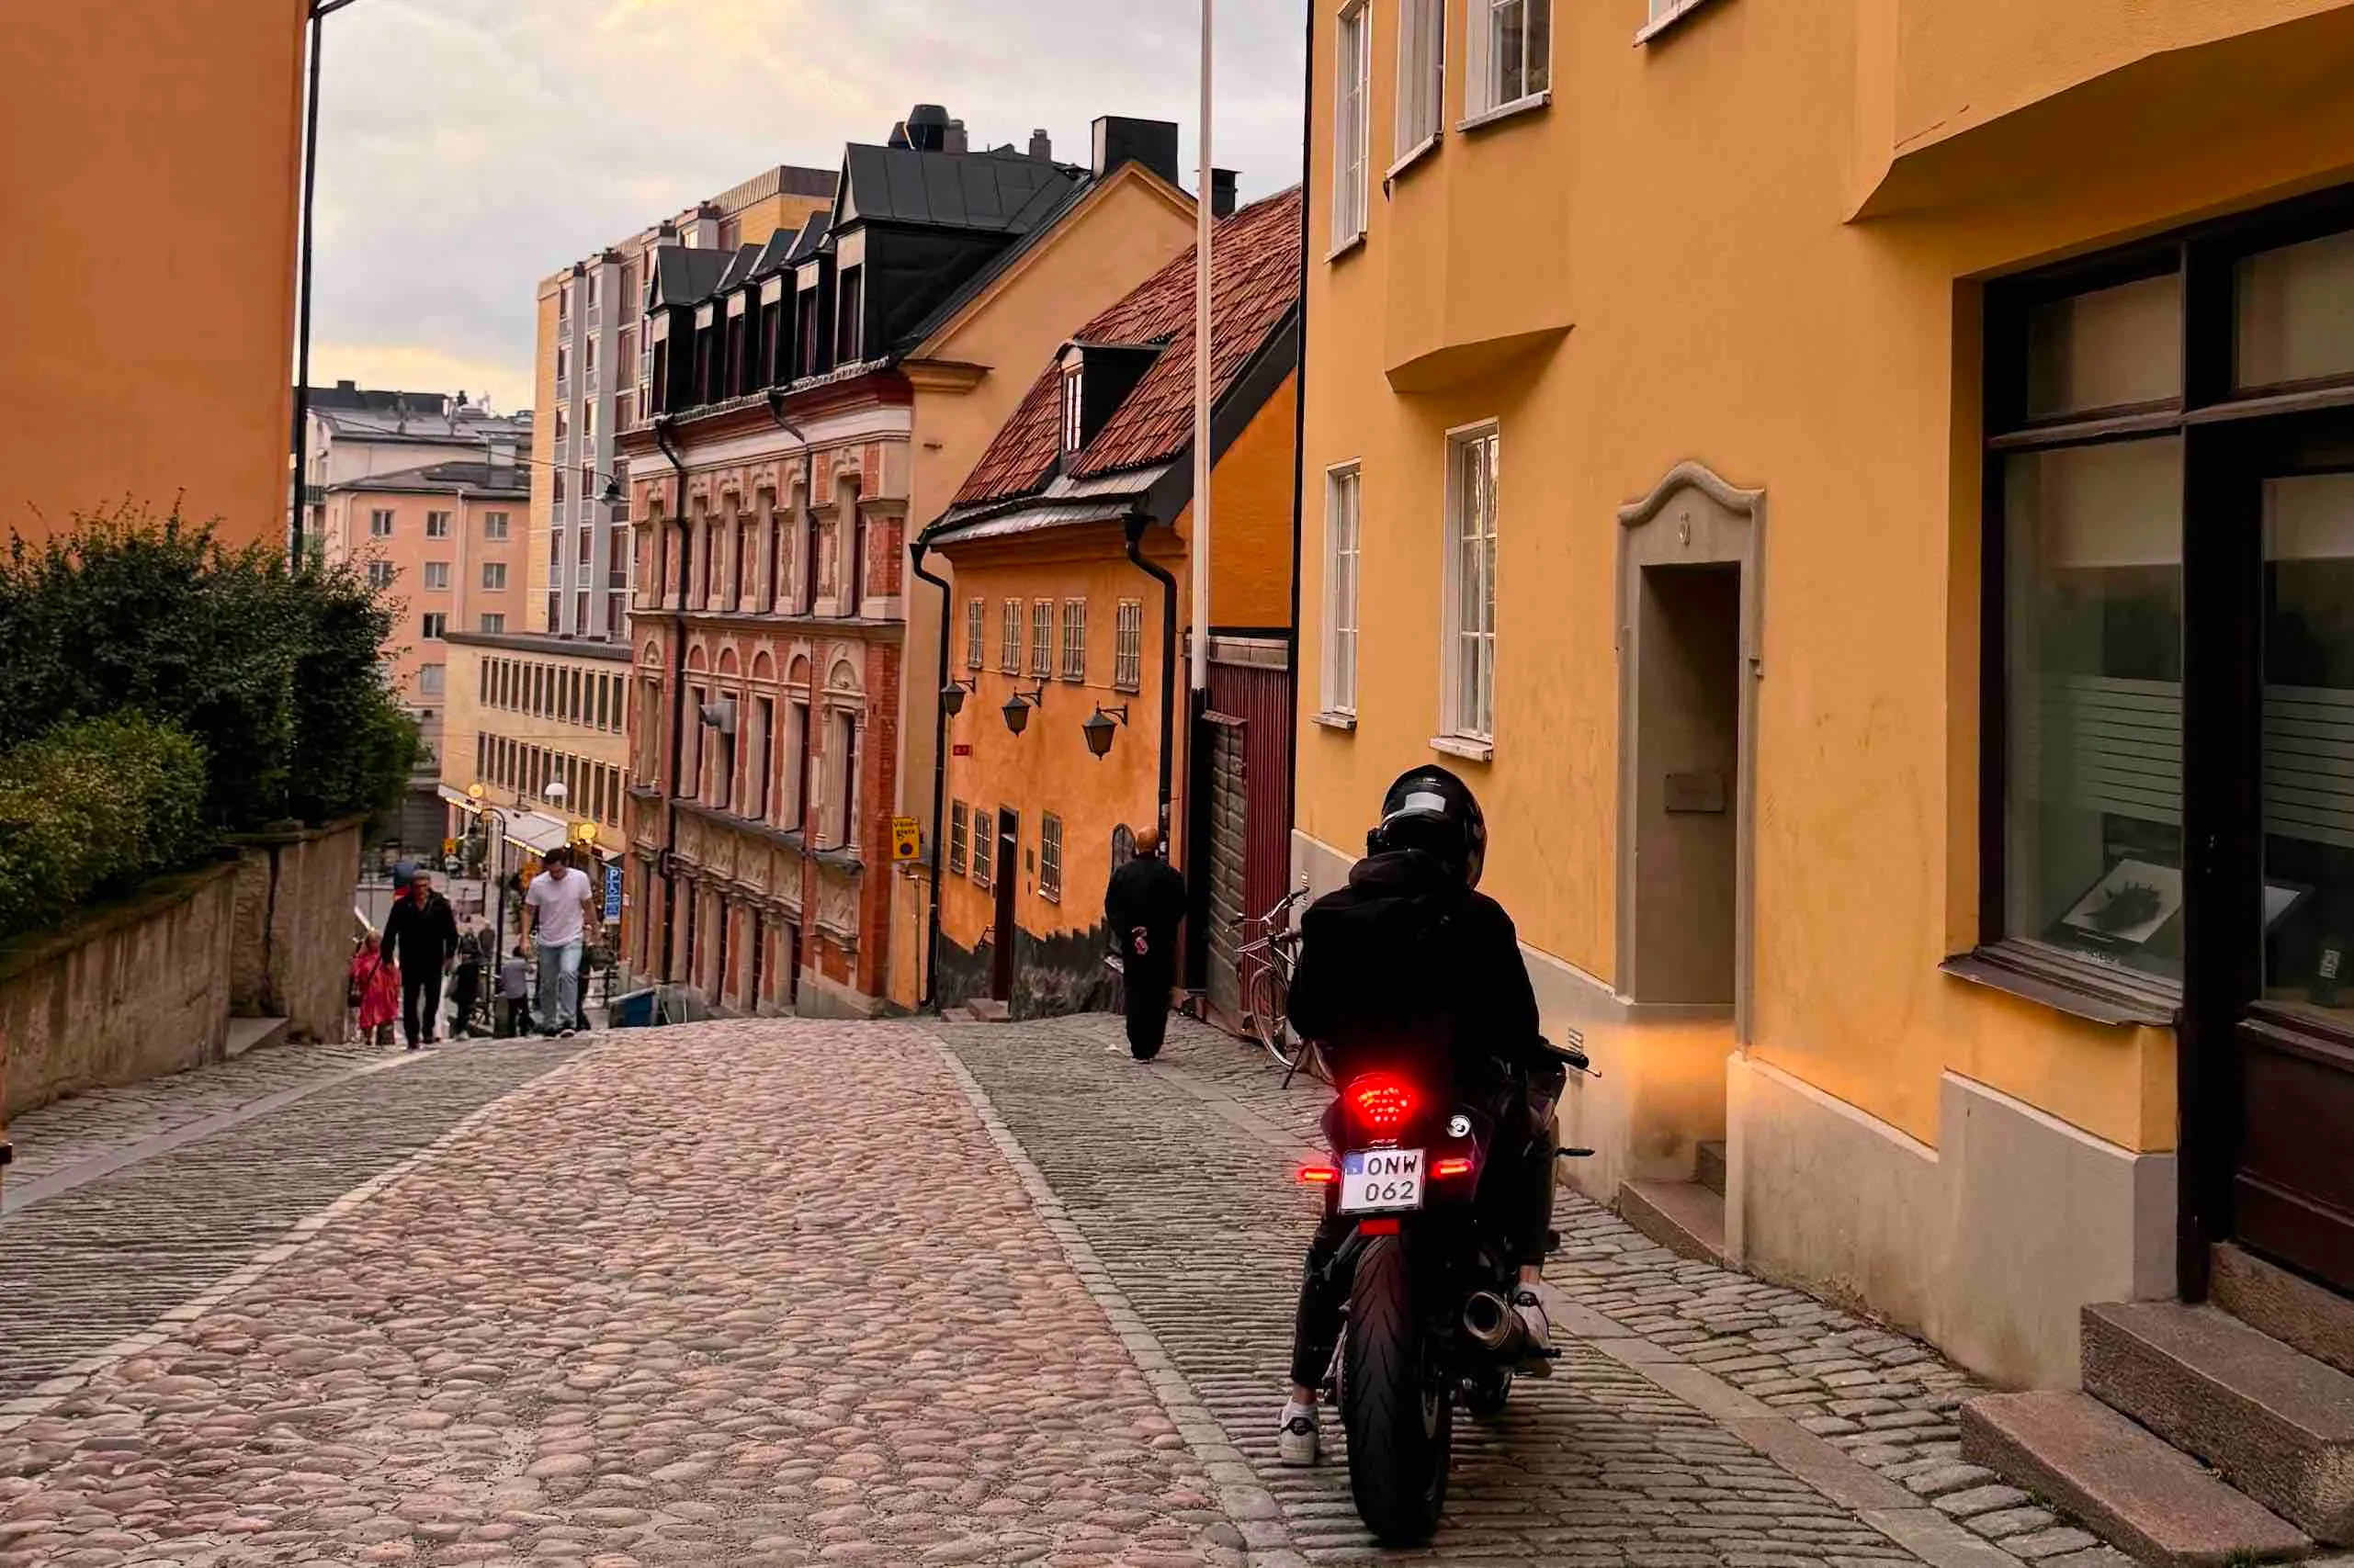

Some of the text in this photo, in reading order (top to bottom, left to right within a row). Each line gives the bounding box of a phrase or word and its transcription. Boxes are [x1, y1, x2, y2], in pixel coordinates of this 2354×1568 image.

[610, 870, 619, 882] P
[1367, 1155, 1418, 1176] ONW
[1364, 1180, 1414, 1201] 062
